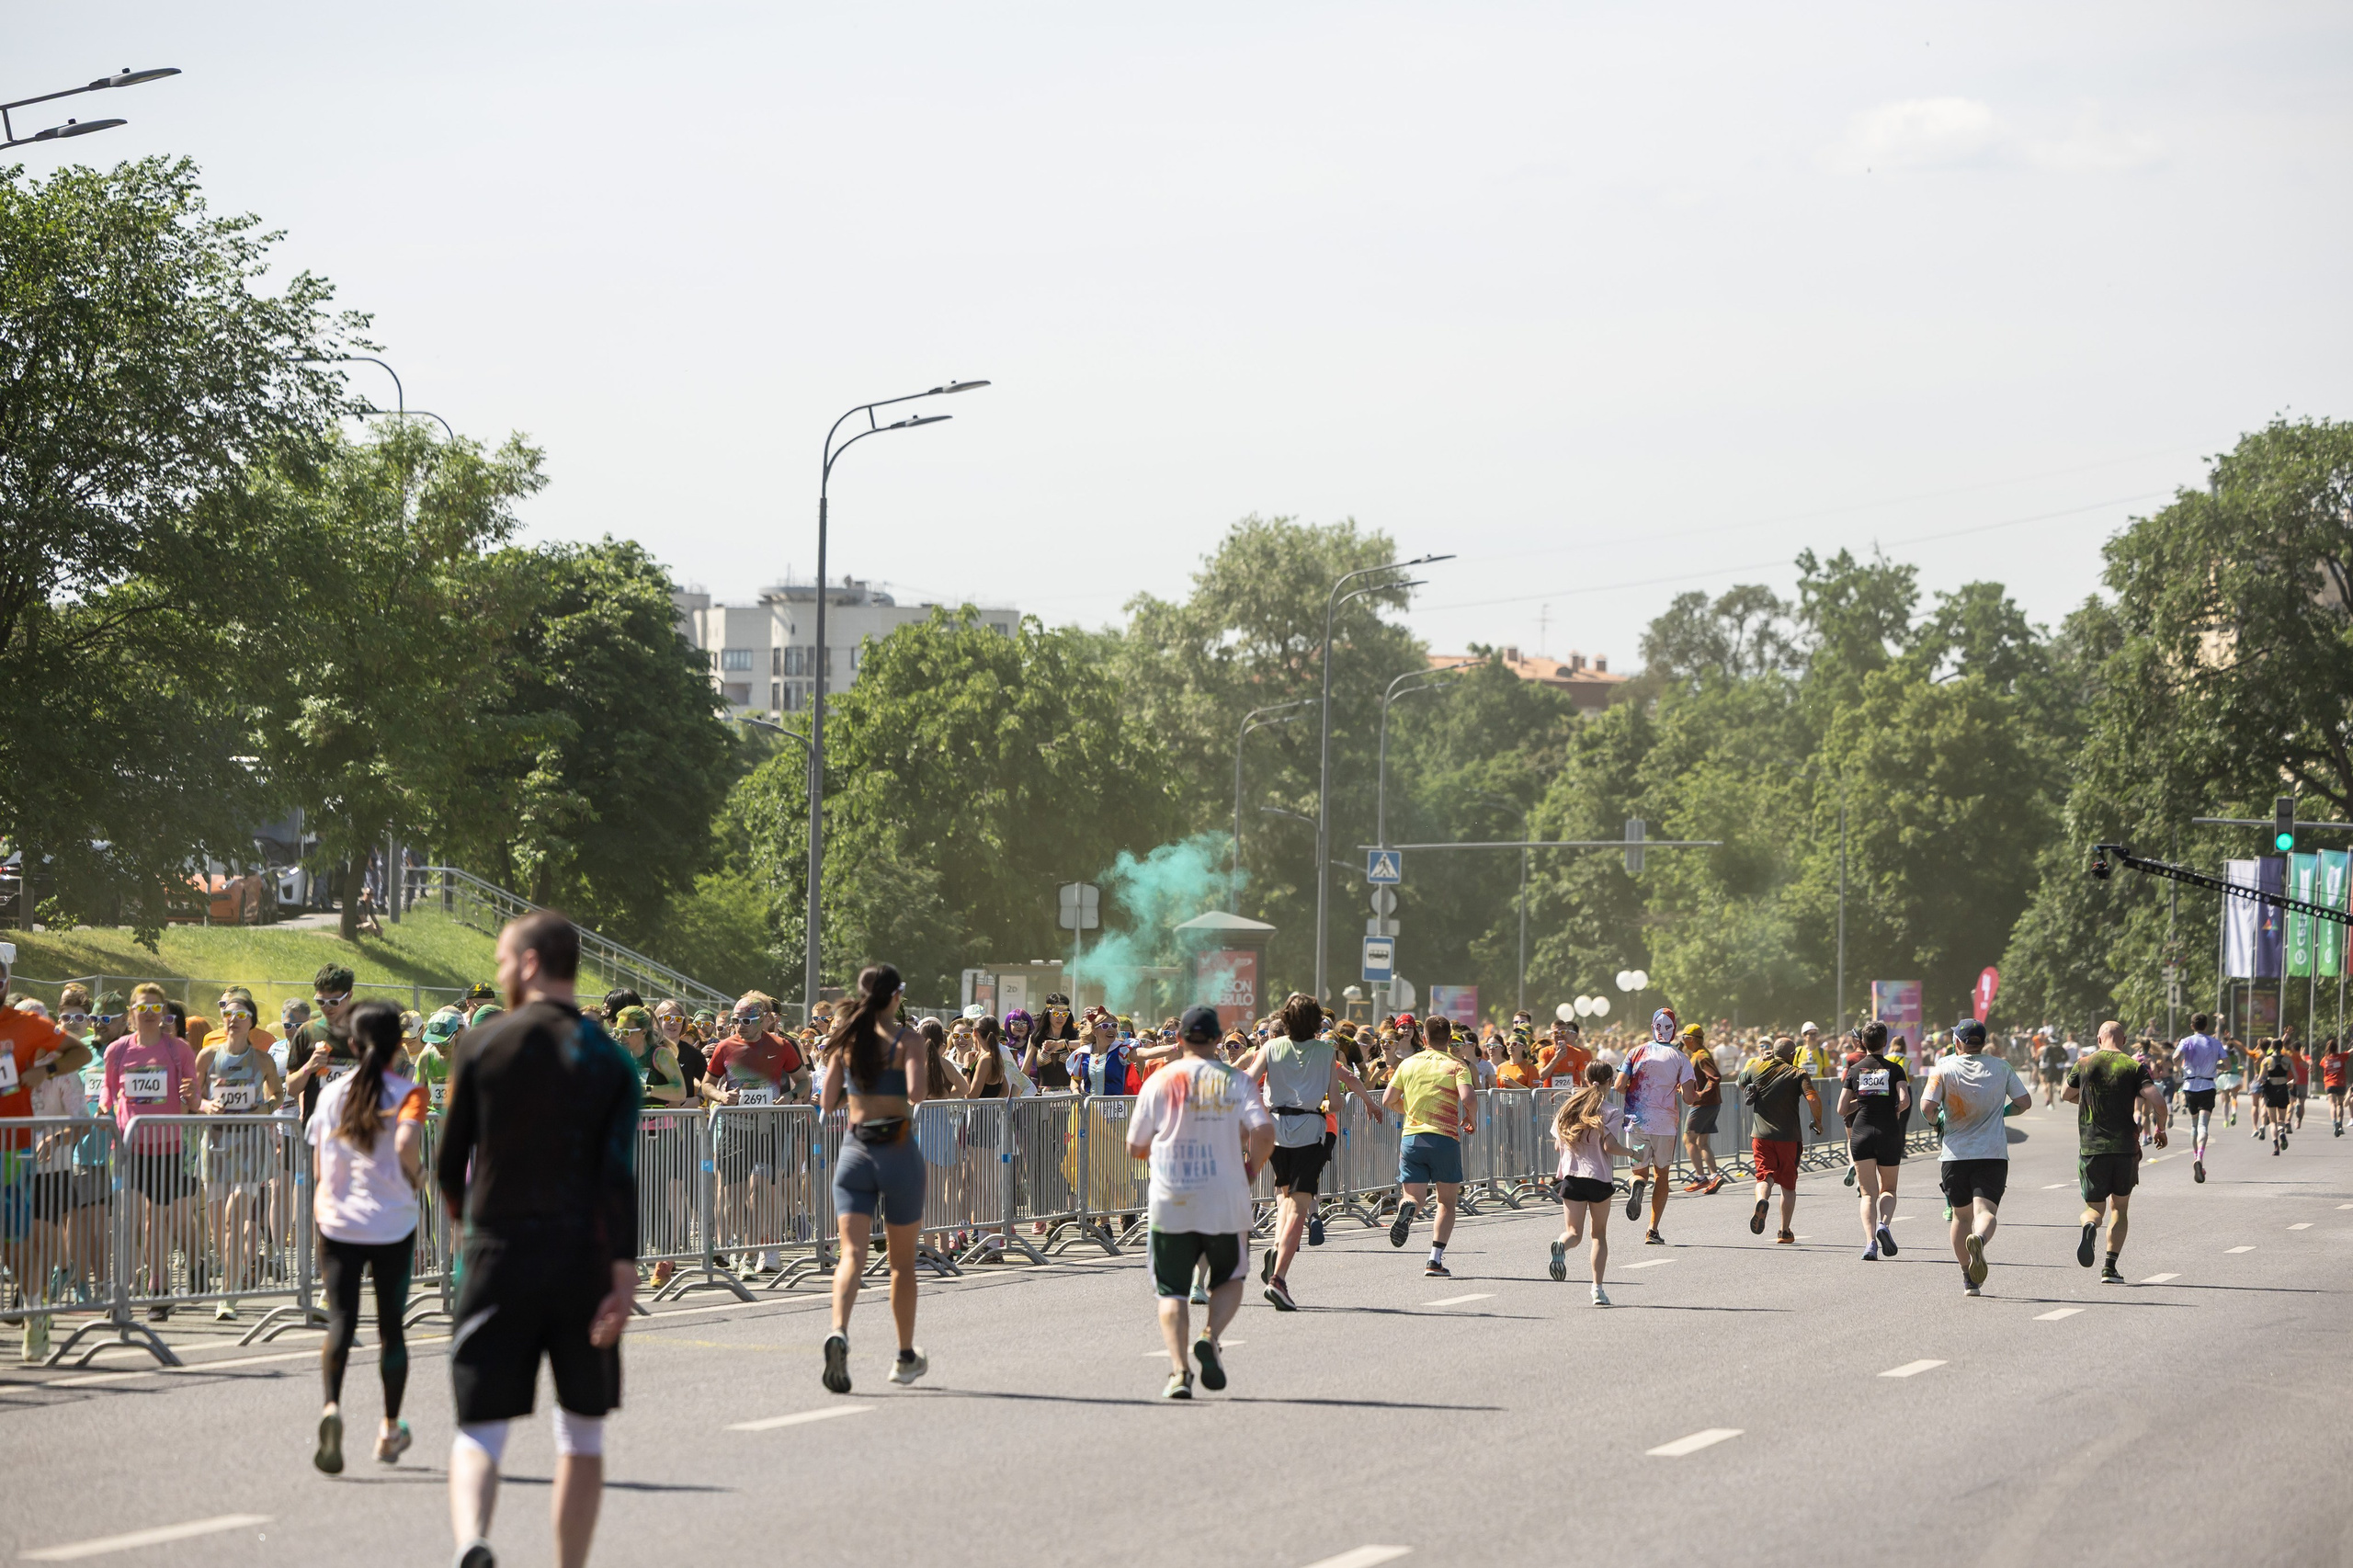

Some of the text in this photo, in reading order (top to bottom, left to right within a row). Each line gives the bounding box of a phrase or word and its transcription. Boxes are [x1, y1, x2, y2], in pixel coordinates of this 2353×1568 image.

[1885, 1020, 1919, 1029] ТАРТ
[89, 1078, 105, 1090] 37
[131, 1079, 160, 1091] 1740
[1863, 1077, 1885, 1086] 3304
[744, 1094, 767, 1105] 2691
